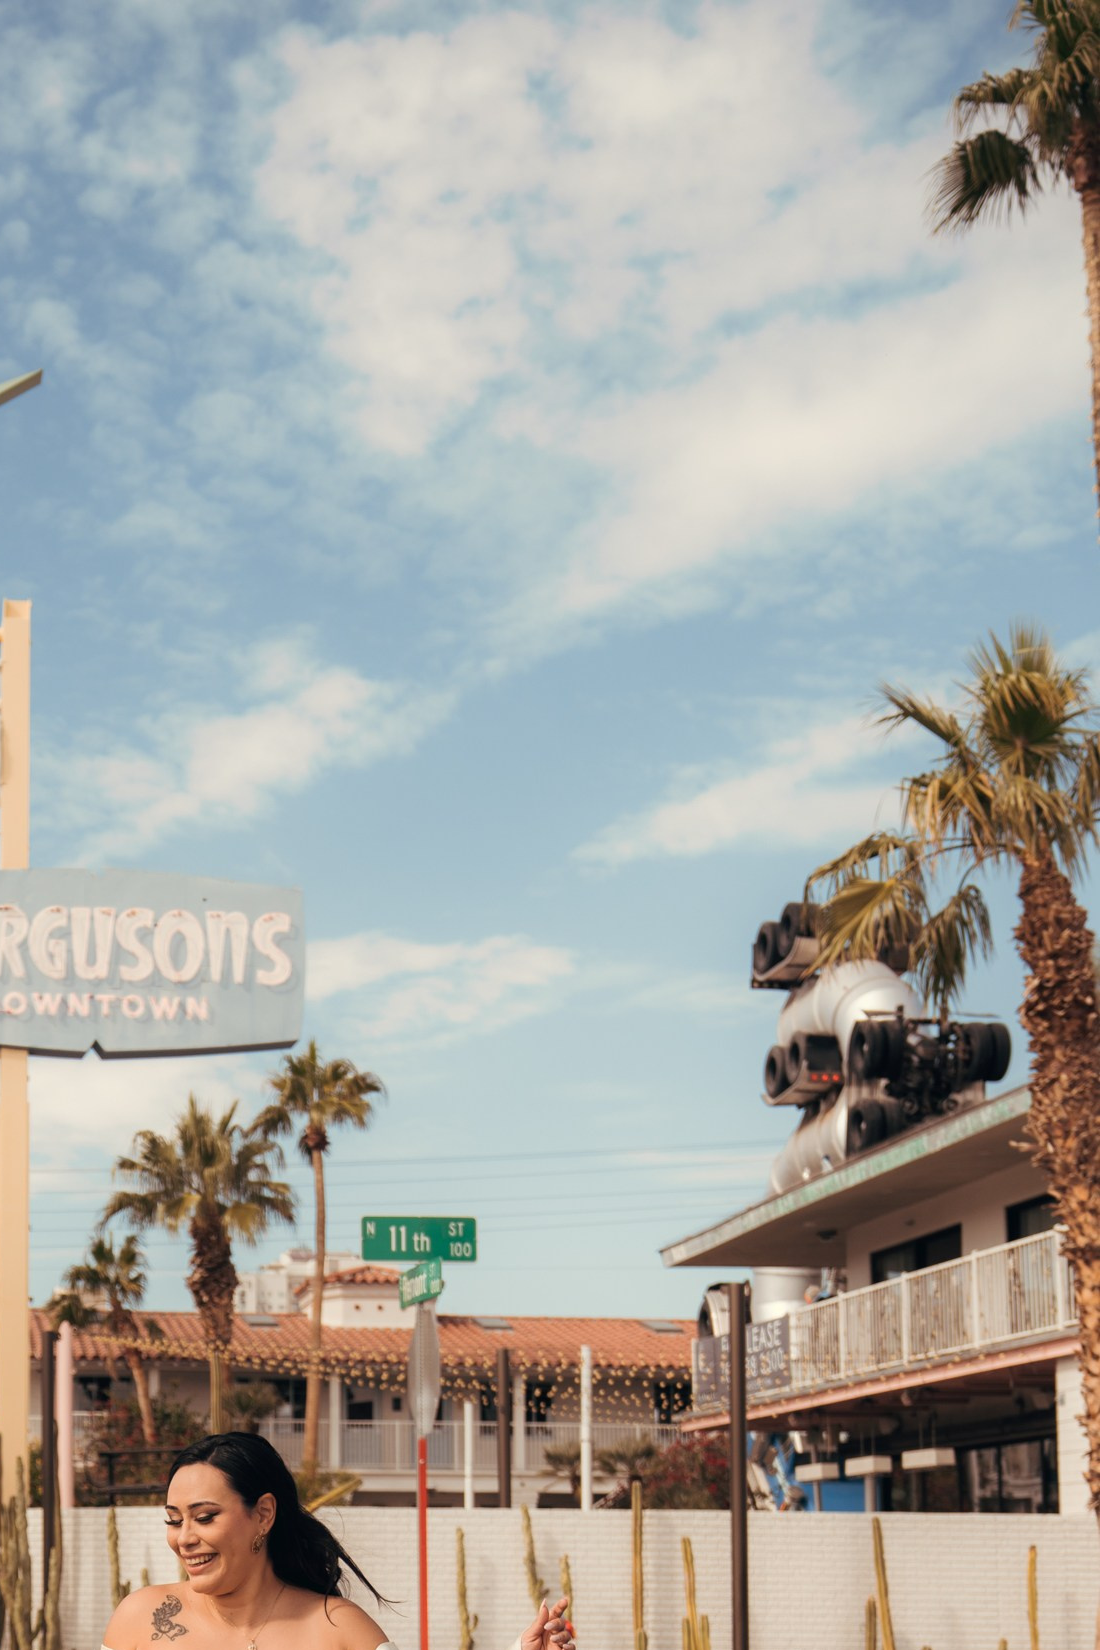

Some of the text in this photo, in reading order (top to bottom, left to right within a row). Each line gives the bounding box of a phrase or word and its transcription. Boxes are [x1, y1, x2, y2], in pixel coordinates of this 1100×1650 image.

[366, 1222, 375, 1235] N
[448, 1222, 464, 1236] ST
[450, 1242, 471, 1257] 100
[746, 1320, 782, 1353] LEASE
